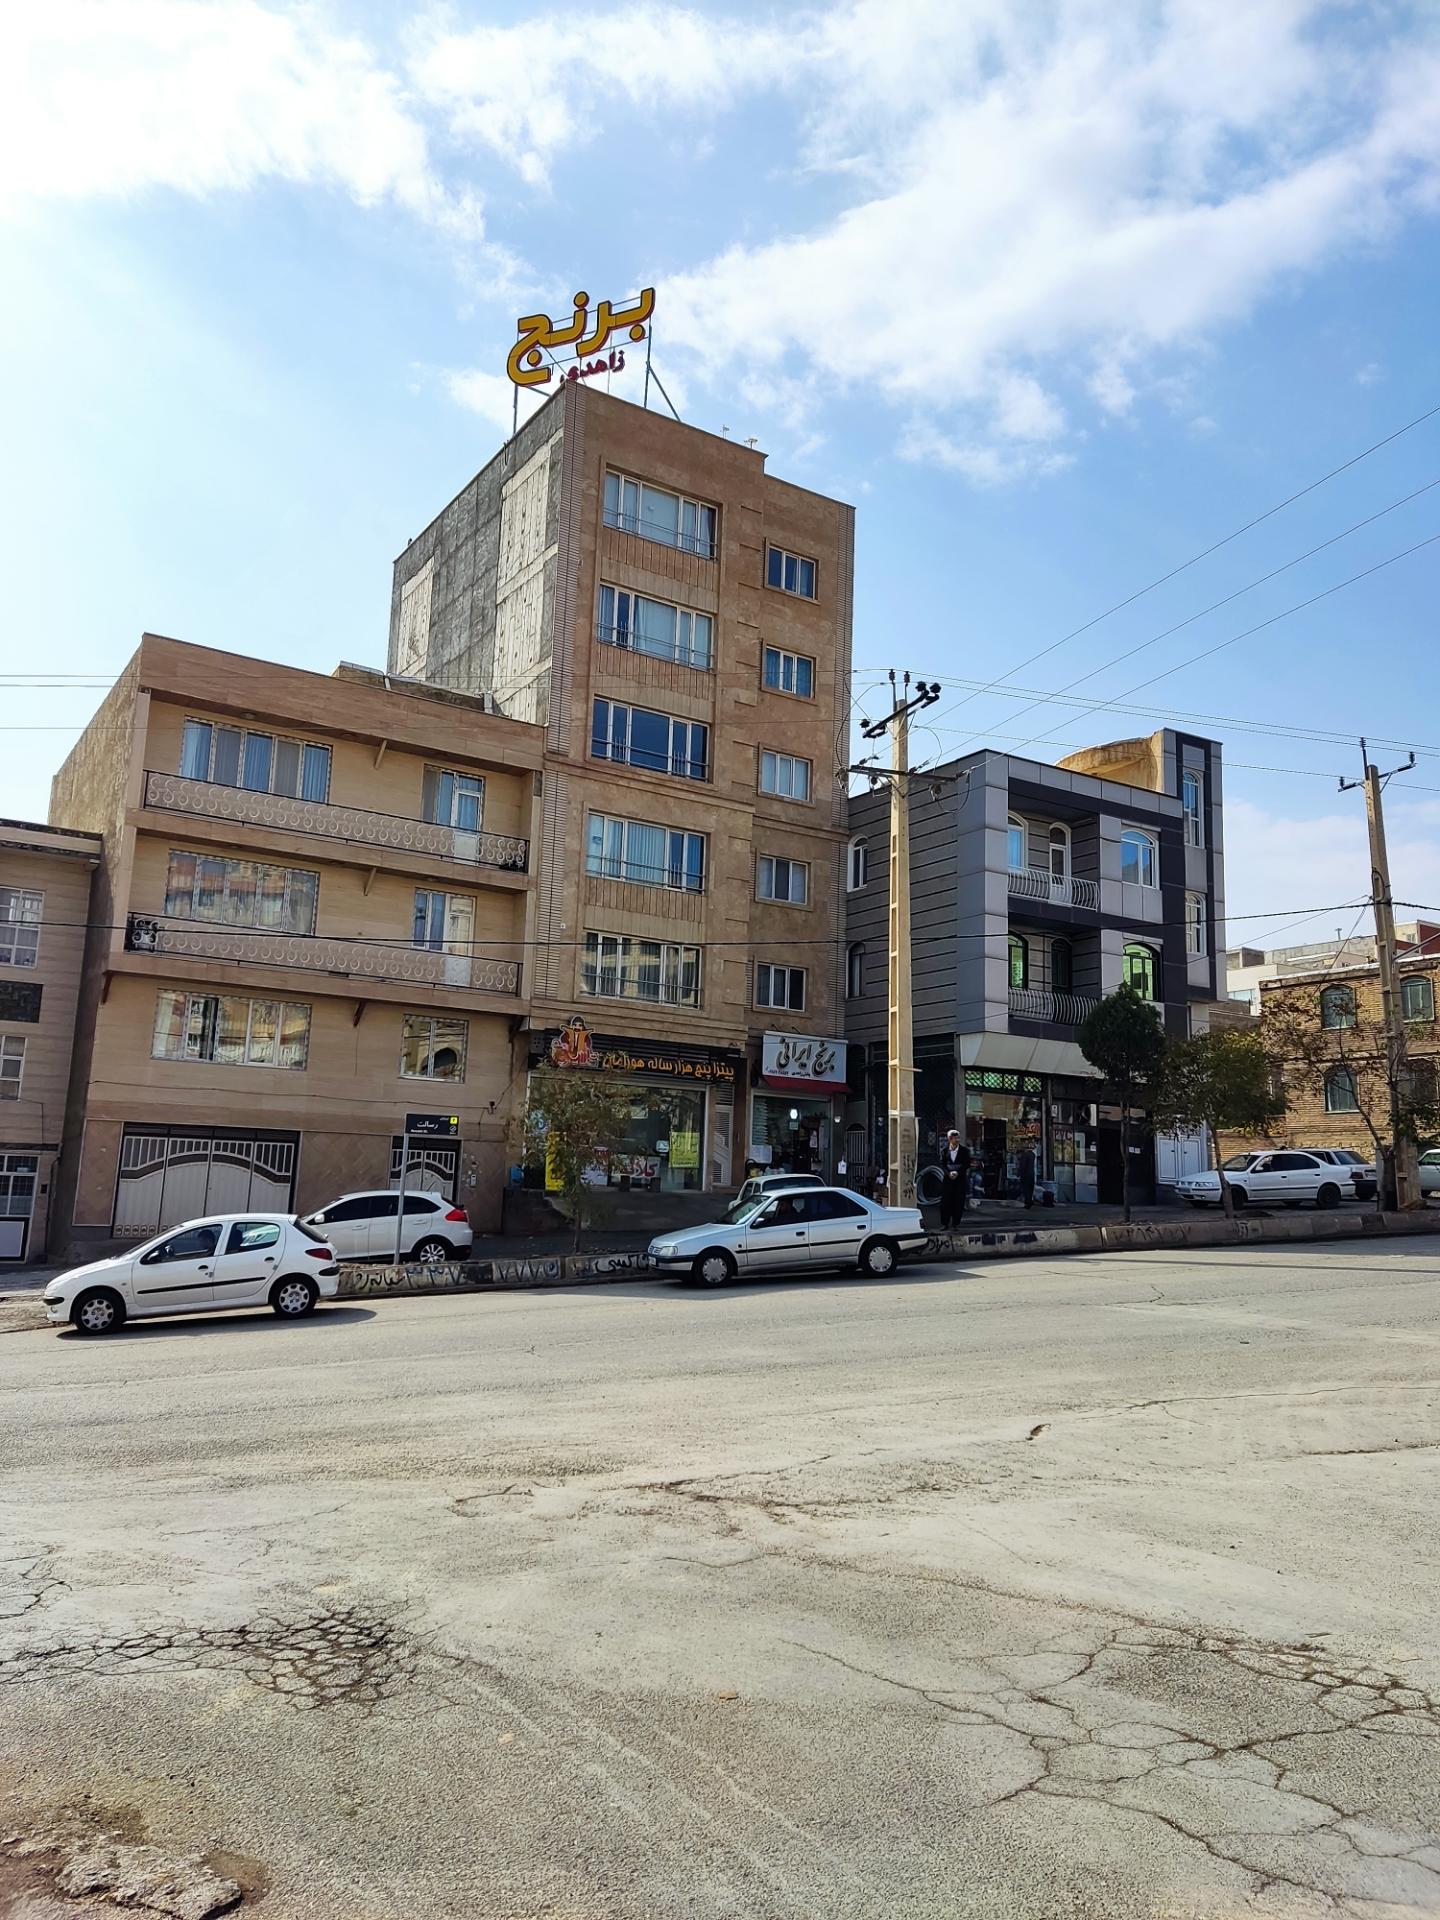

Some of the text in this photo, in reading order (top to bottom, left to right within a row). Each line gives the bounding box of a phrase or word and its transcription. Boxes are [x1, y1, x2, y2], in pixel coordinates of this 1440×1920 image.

[507, 287, 656, 387] برنج
[560, 349, 626, 383] زاهدی
[647, 1056, 673, 1071] ساله
[674, 1057, 693, 1076] هزار
[776, 1037, 836, 1077] برنج ایرانی
[694, 1061, 712, 1081] پنج
[713, 1060, 735, 1082] پیتزا
[417, 1120, 439, 1130] رسالت
